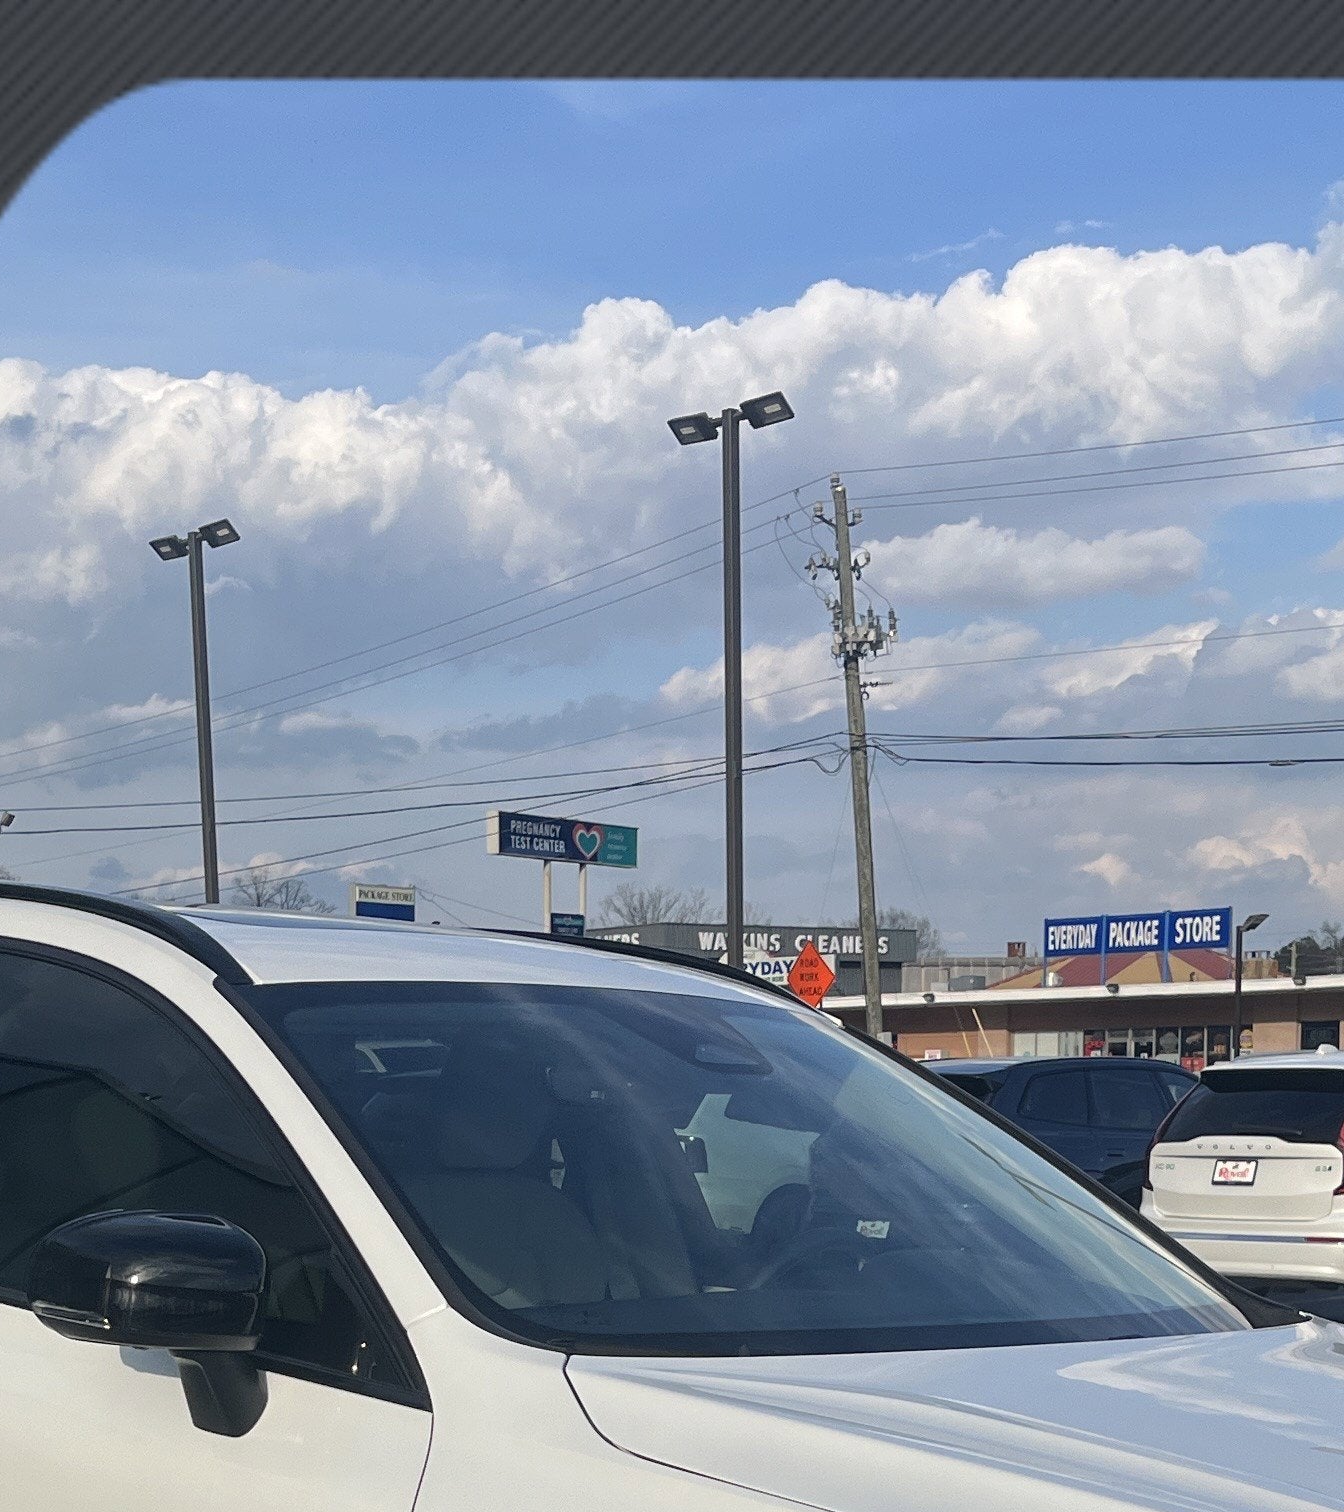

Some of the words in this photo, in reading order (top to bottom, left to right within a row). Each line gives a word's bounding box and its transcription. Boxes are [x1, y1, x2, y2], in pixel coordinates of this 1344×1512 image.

[510, 820, 561, 838] PREGNANCY
[510, 835, 531, 850] TEST
[533, 837, 566, 853] CENTER
[1048, 923, 1098, 951] EVERYDAY
[1109, 919, 1160, 948] PACKAGE
[1174, 915, 1221, 944] STORE
[698, 931, 781, 951] WAINS
[794, 934, 889, 954] CEANES
[799, 958, 819, 968] ROAD
[799, 972, 819, 982] WORK
[799, 987, 823, 996] AHEAD
